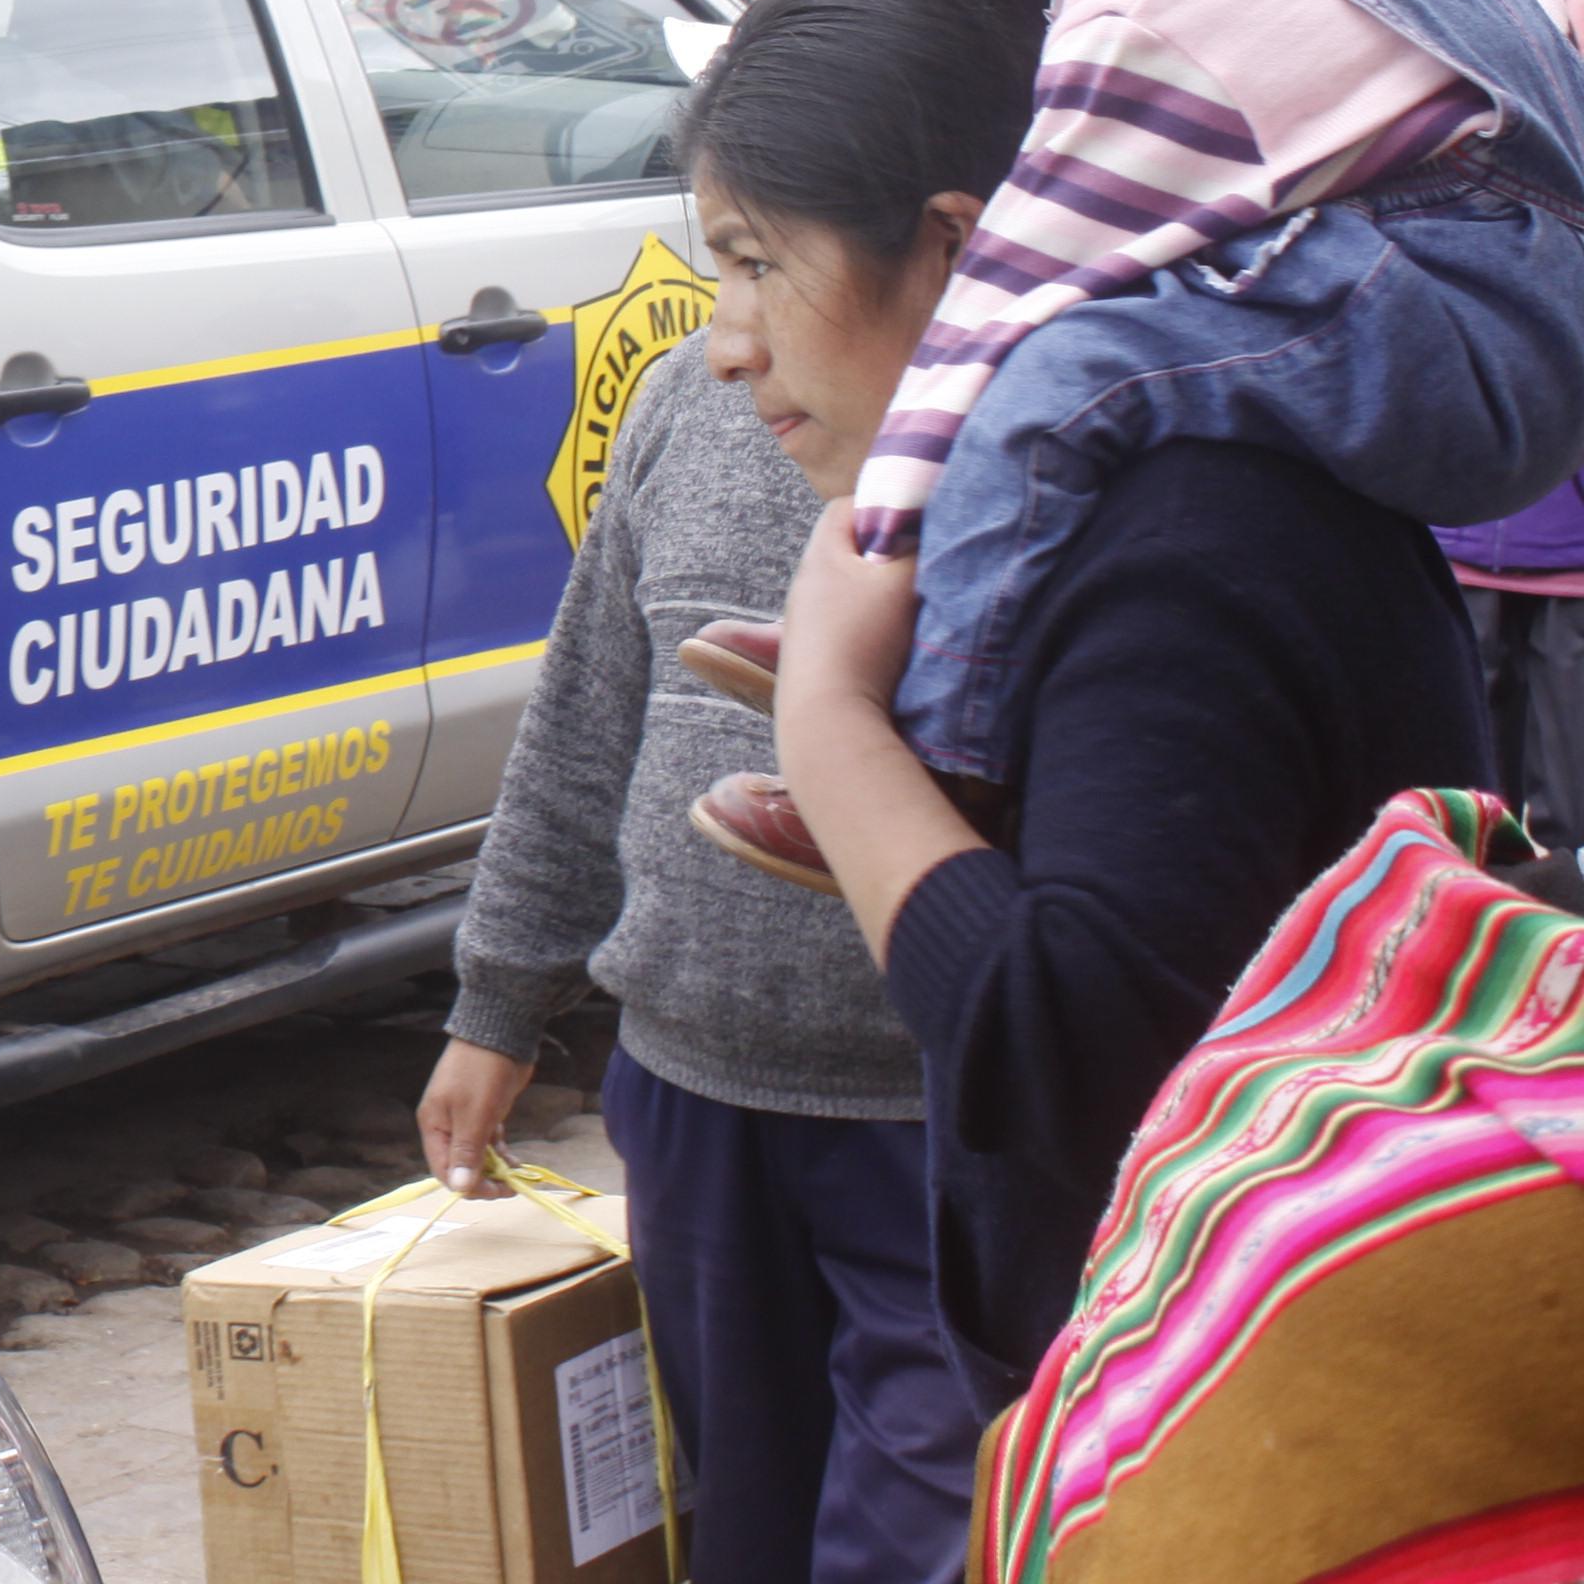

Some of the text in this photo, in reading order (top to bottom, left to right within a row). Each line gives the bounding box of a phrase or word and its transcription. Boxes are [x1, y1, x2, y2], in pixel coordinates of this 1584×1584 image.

[10, 444, 388, 594] SEGURIDAD
[7, 550, 388, 707] CIUDADANA
[42, 719, 392, 859] TE PROTEGEMOS
[63, 797, 349, 918] TE CUIDAMOS
